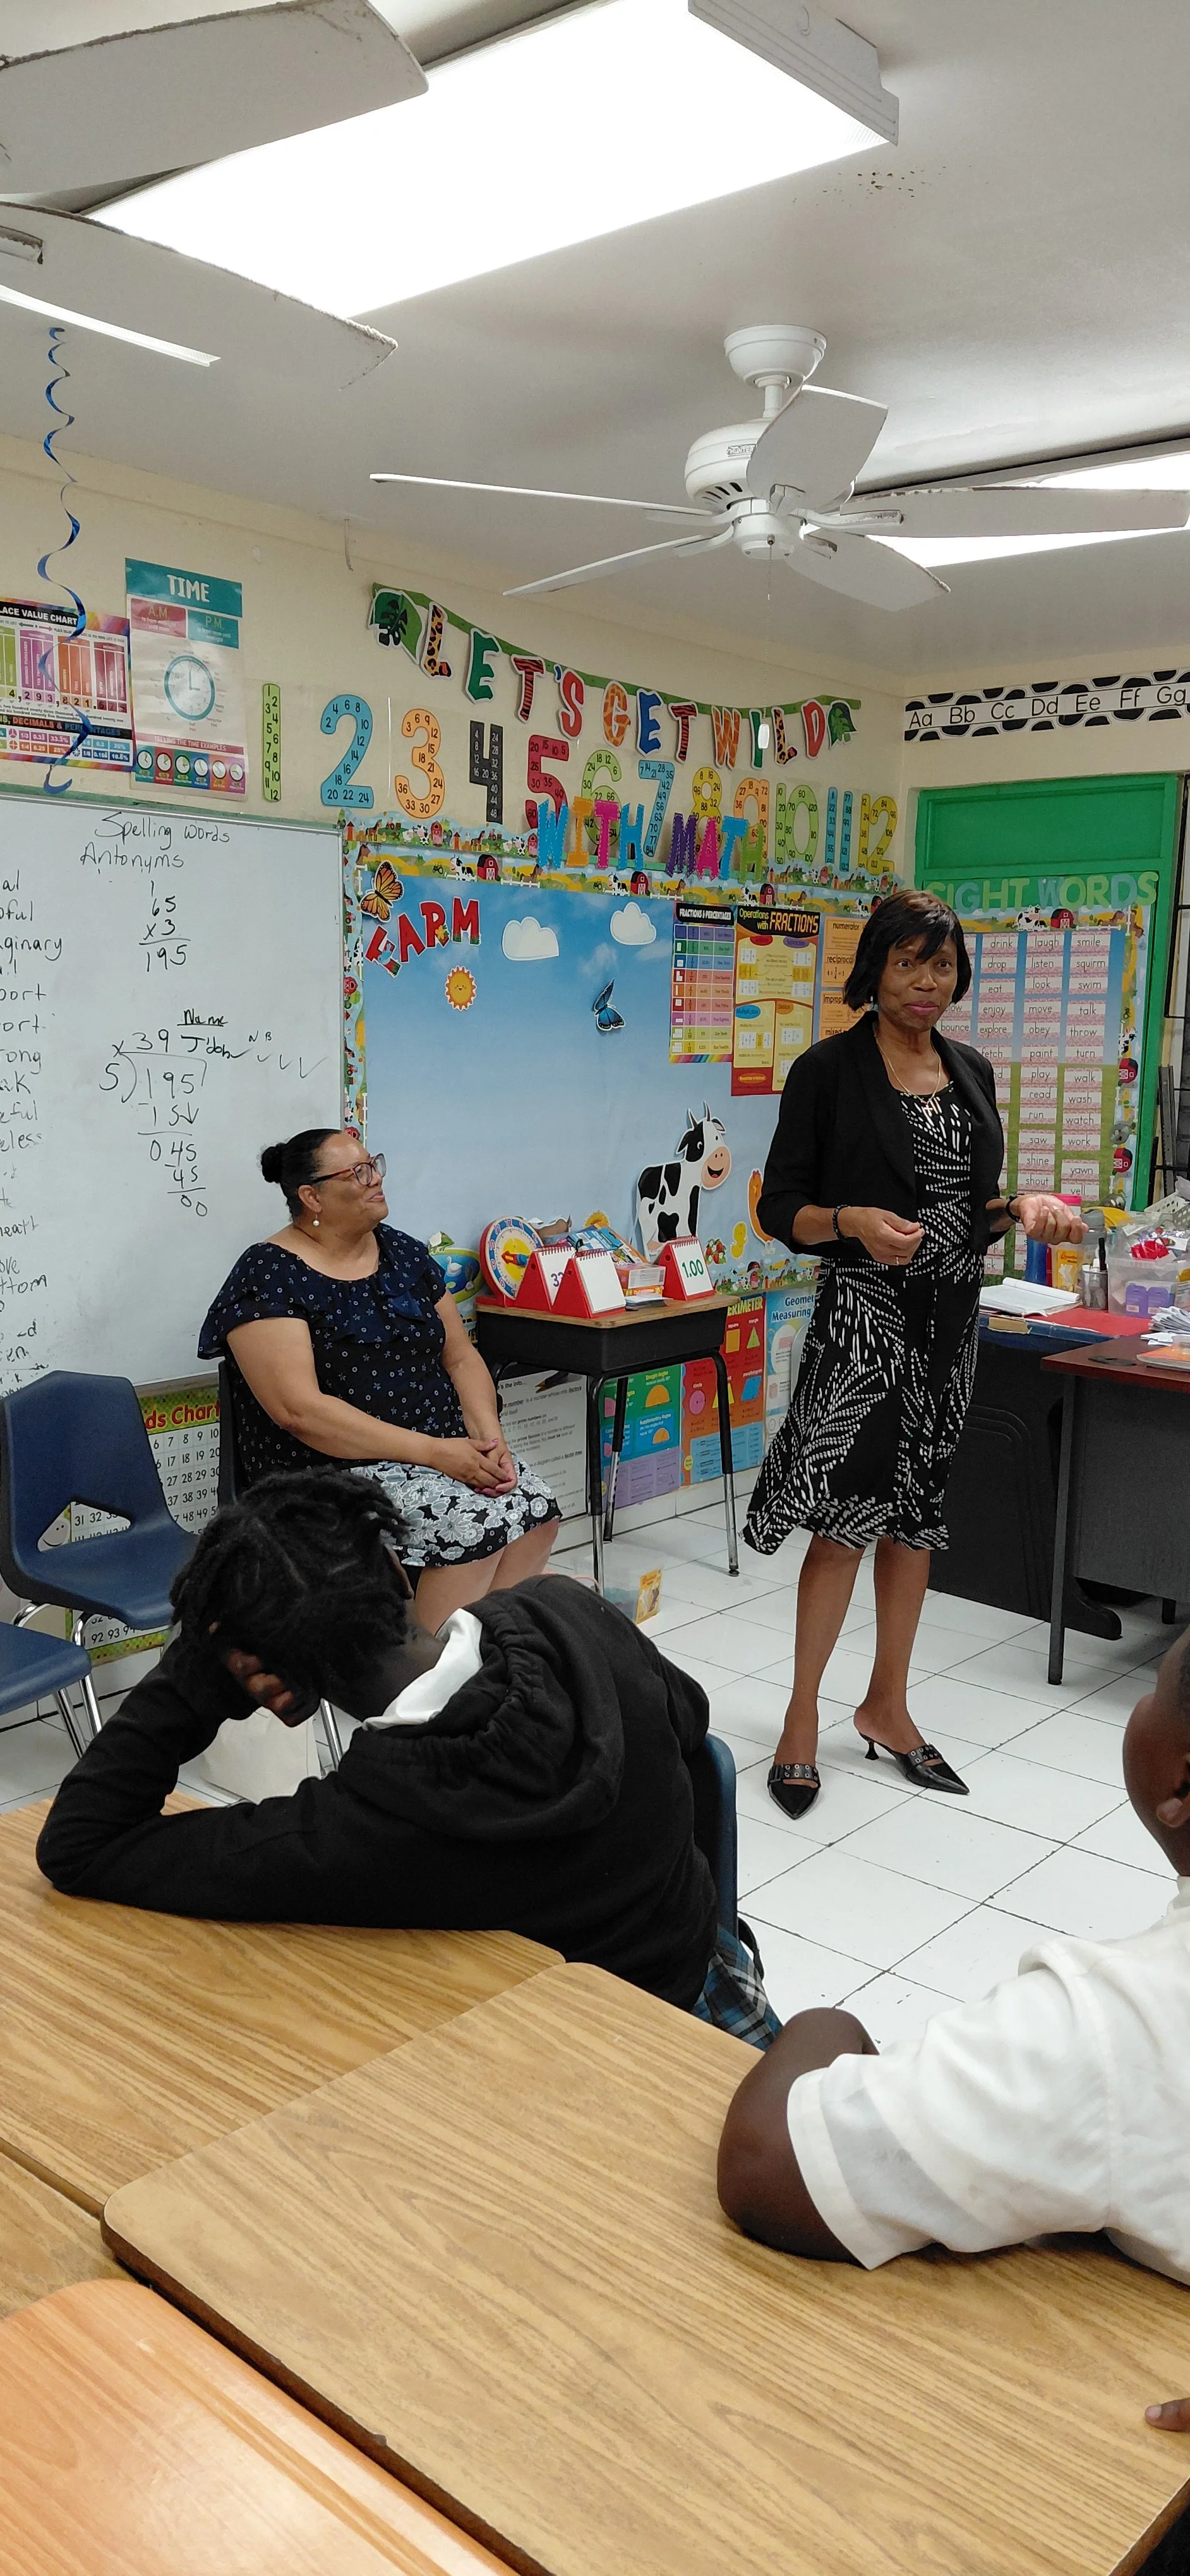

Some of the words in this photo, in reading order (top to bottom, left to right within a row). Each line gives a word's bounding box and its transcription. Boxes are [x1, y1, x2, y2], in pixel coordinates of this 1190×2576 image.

[167, 574, 210, 603] TIME
[21, 609, 49, 620] VALUE
[51, 614, 78, 626] CHART
[421, 601, 584, 740] LET'S
[603, 680, 698, 765] GET
[711, 698, 826, 771] WILD
[332, 703, 339, 713] 4
[345, 700, 350, 710] 6
[355, 702, 361, 712] 8
[909, 710, 934, 729] Aa
[949, 705, 976, 725] Bb
[990, 703, 1015, 720] Cc
[1031, 696, 1059, 717] Dd
[1076, 693, 1102, 713] Ee
[1120, 688, 1141, 708] Ff
[1157, 686, 1187, 707] Gg
[12, 717, 54, 729] DECIMALS
[325, 717, 332, 727] 2
[361, 719, 369, 730] 10
[424, 715, 430, 725] 9
[431, 728, 438, 739] 12
[154, 736, 176, 744] TELLING
[188, 740, 200, 748] TIME
[200, 742, 227, 751] EXAMPLES
[357, 736, 365, 746] 12
[428, 742, 435, 753] 15
[351, 749, 359, 760] 14
[418, 752, 426, 763] 18
[343, 763, 351, 774] 16
[335, 774, 343, 785] 18
[433, 778, 443, 788] 24
[397, 783, 408, 794] 36
[327, 789, 339, 800] 20
[343, 789, 354, 800] 22
[359, 792, 370, 802] 24
[431, 794, 440, 804] 27
[95, 812, 172, 850] Spelling
[536, 796, 644, 871] WITH
[665, 812, 764, 883] MATH
[80, 842, 184, 873] Antonyms
[1037, 871, 1158, 912] WORDS
[152, 896, 176, 916] 65
[679, 908, 702, 919] FRACTIONS
[706, 910, 731, 921] PERCENTAGES
[739, 909, 769, 921] Operations
[757, 921, 769, 930] with
[770, 911, 819, 934] FRACTIONS
[832, 922, 860, 931] numerator
[364, 897, 482, 978] FARM
[990, 937, 1013, 948] drink
[1035, 934, 1059, 951] laugh
[1077, 935, 1100, 946] smile
[0, 936, 62, 965] ginary
[147, 945, 188, 972] 195
[988, 957, 1006, 972] drop
[1031, 957, 1054, 968] listen
[1076, 960, 1105, 973] squirm
[1033, 977, 1050, 989] look
[989, 985, 1002, 994] eat
[824, 995, 842, 1004] improp
[983, 1005, 1006, 1018] enjoy
[1079, 1004, 1097, 1015] talk
[183, 1008, 228, 1026] Name
[941, 1020, 970, 1032] bounce
[980, 1022, 1007, 1037] explore
[1029, 1022, 1050, 1037] obey
[1071, 1025, 1097, 1037] throw
[132, 1029, 169, 1052] 39
[982, 1047, 1002, 1058] fetch
[1030, 1049, 1053, 1061] paint
[1076, 1049, 1095, 1058] turn
[1031, 1067, 1050, 1082] play
[1074, 1071, 1096, 1082] walk
[147, 1068, 195, 1099] 195
[1029, 1088, 1051, 1099] read
[1069, 1092, 1091, 1104] wash
[1066, 1113, 1094, 1124] watch
[1068, 1135, 1090, 1146] work
[1026, 1154, 1049, 1165] shine
[1070, 1168, 1093, 1178] yawn
[1026, 1174, 1049, 1186] shout
[682, 1258, 704, 1279] 1.00
[728, 1296, 764, 1316] ERIMETER
[785, 1294, 815, 1308] Geomet
[772, 1308, 812, 1321] Measuring
[171, 1400, 220, 1424] Chart
[153, 1439, 160, 1449] 6
[168, 1437, 174, 1447] 7
[183, 1434, 189, 1444] 8
[198, 1431, 203, 1441] 9
[210, 1428, 219, 1438] 10
[167, 1456, 176, 1467] 17
[183, 1453, 190, 1464] 18
[196, 1450, 205, 1461] 19
[210, 1448, 220, 1458] 20
[167, 1476, 178, 1486] 27
[182, 1472, 192, 1483] 28
[195, 1470, 207, 1481] 29
[167, 1495, 178, 1506] 37
[183, 1492, 193, 1503] 38
[196, 1489, 207, 1500] 39
[75, 1515, 85, 1526] 31
[90, 1513, 102, 1524] 32
[183, 1512, 194, 1522] 48
[196, 1509, 208, 1519] 49
[91, 1632, 104, 1643] 92
[107, 1629, 121, 1639] 93
